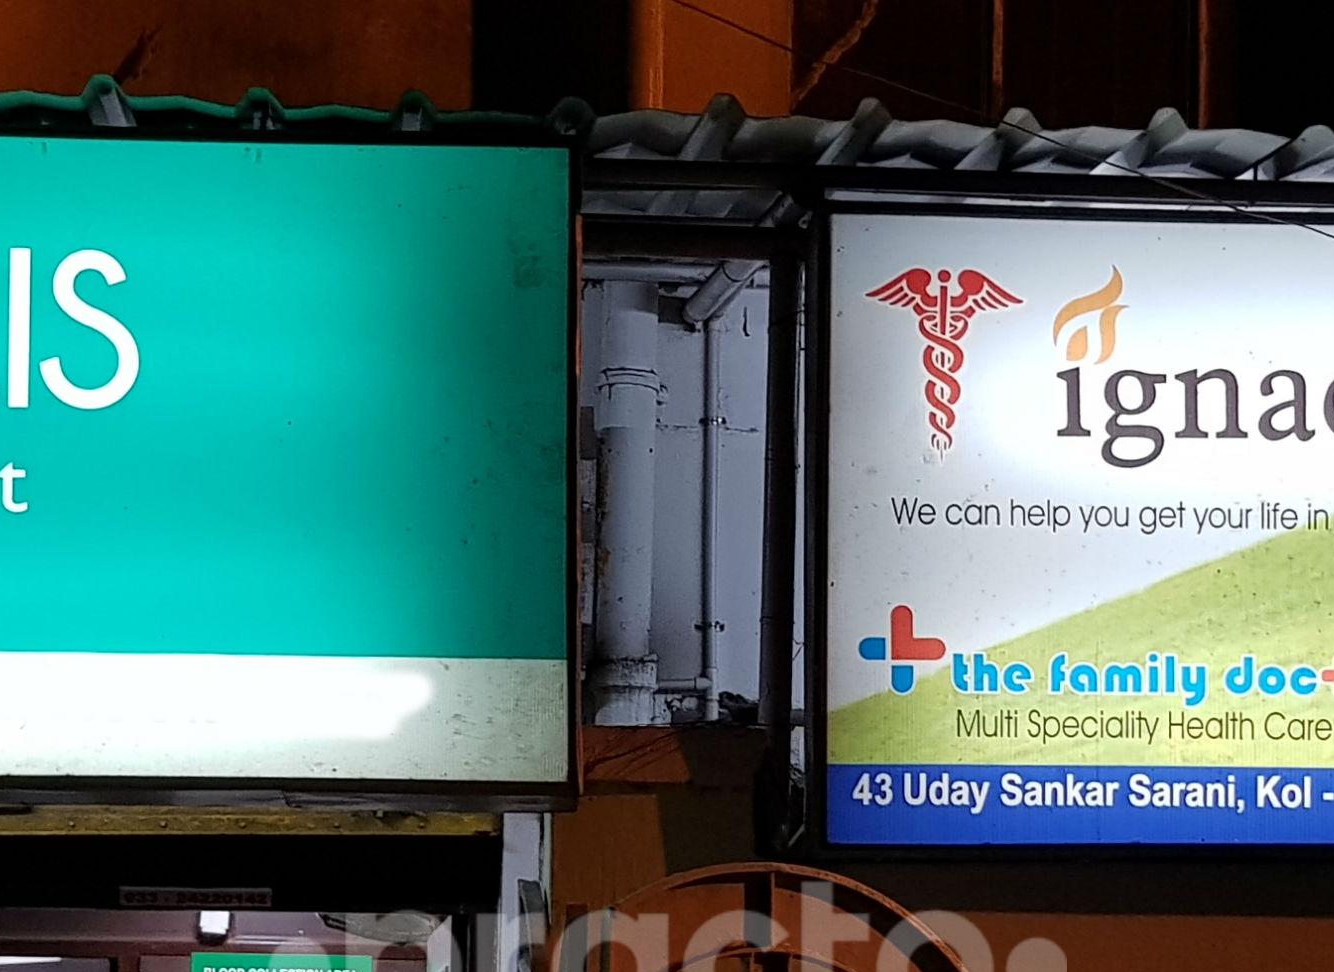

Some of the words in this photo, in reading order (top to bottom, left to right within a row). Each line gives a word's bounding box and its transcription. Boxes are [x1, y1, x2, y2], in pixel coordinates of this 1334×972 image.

[891, 497, 936, 525] We
[945, 503, 1001, 526] can
[1010, 499, 1071, 533] help
[1079, 505, 1130, 533] you
[1139, 501, 1186, 534] get
[1194, 506, 1252, 534] your
[1260, 502, 1299, 530] life
[1307, 503, 1329, 530] in
[952, 652, 1032, 692] the
[1050, 652, 1207, 707] family
[957, 709, 1018, 738] Multi
[1027, 709, 1159, 745] Speciality
[1169, 711, 1254, 740] Health
[1264, 711, 1332, 741] Care
[852, 773, 893, 806] 43
[904, 773, 990, 814] Uday
[1000, 773, 1120, 807] Sankar
[1128, 774, 1244, 813] Sarani,
[1257, 775, 1311, 809] Kol
